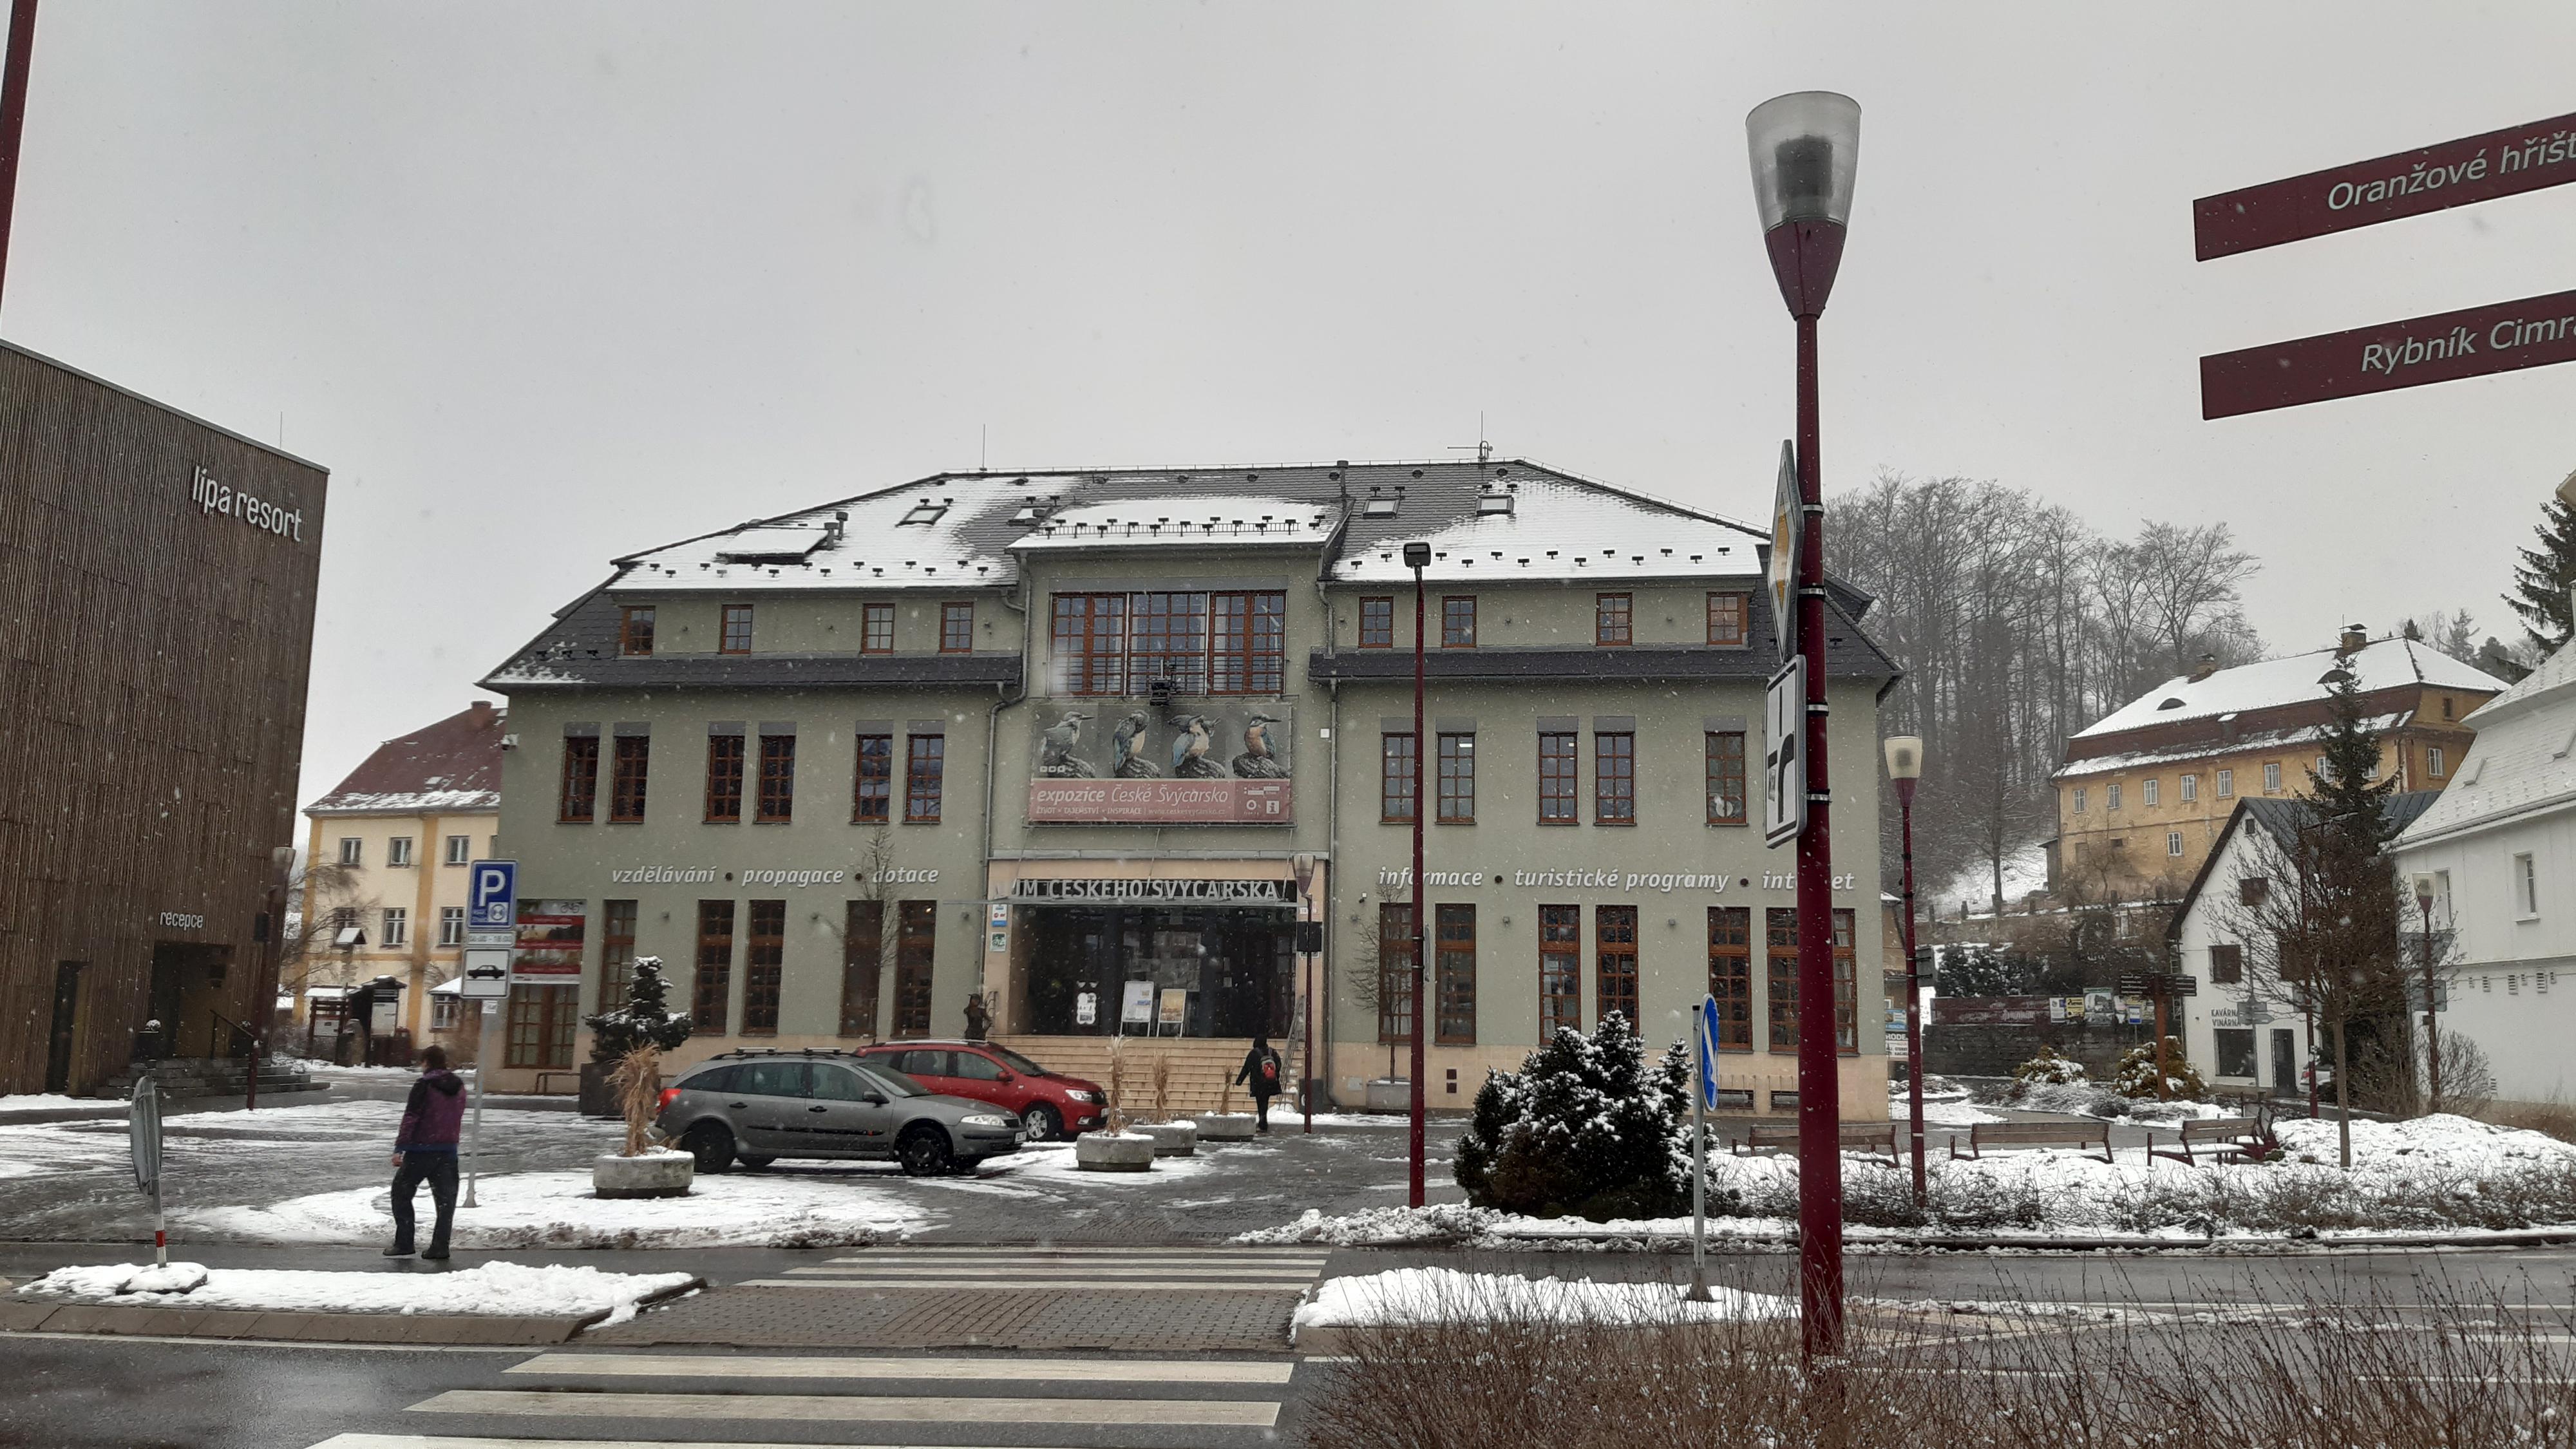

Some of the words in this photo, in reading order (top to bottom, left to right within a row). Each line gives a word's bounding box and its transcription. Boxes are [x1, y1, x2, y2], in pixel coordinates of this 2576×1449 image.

[2328, 148, 2488, 210] Oranžové
[2361, 325, 2478, 375] Rybník
[2490, 316, 2576, 350] Cimr
[235, 491, 302, 542] resort
[1037, 786, 1106, 806] expozice
[1112, 783, 1151, 802] České
[1158, 784, 1229, 806] Švýcarsko
[478, 869, 506, 907] P
[612, 865, 717, 884] vzdělávání
[741, 867, 844, 887] propagace
[873, 866, 939, 884] dotace
[1515, 868, 1620, 887] turistické
[1625, 872, 1730, 893] programy
[1762, 870, 1855, 889] intet
[159, 911, 204, 931] recepce
